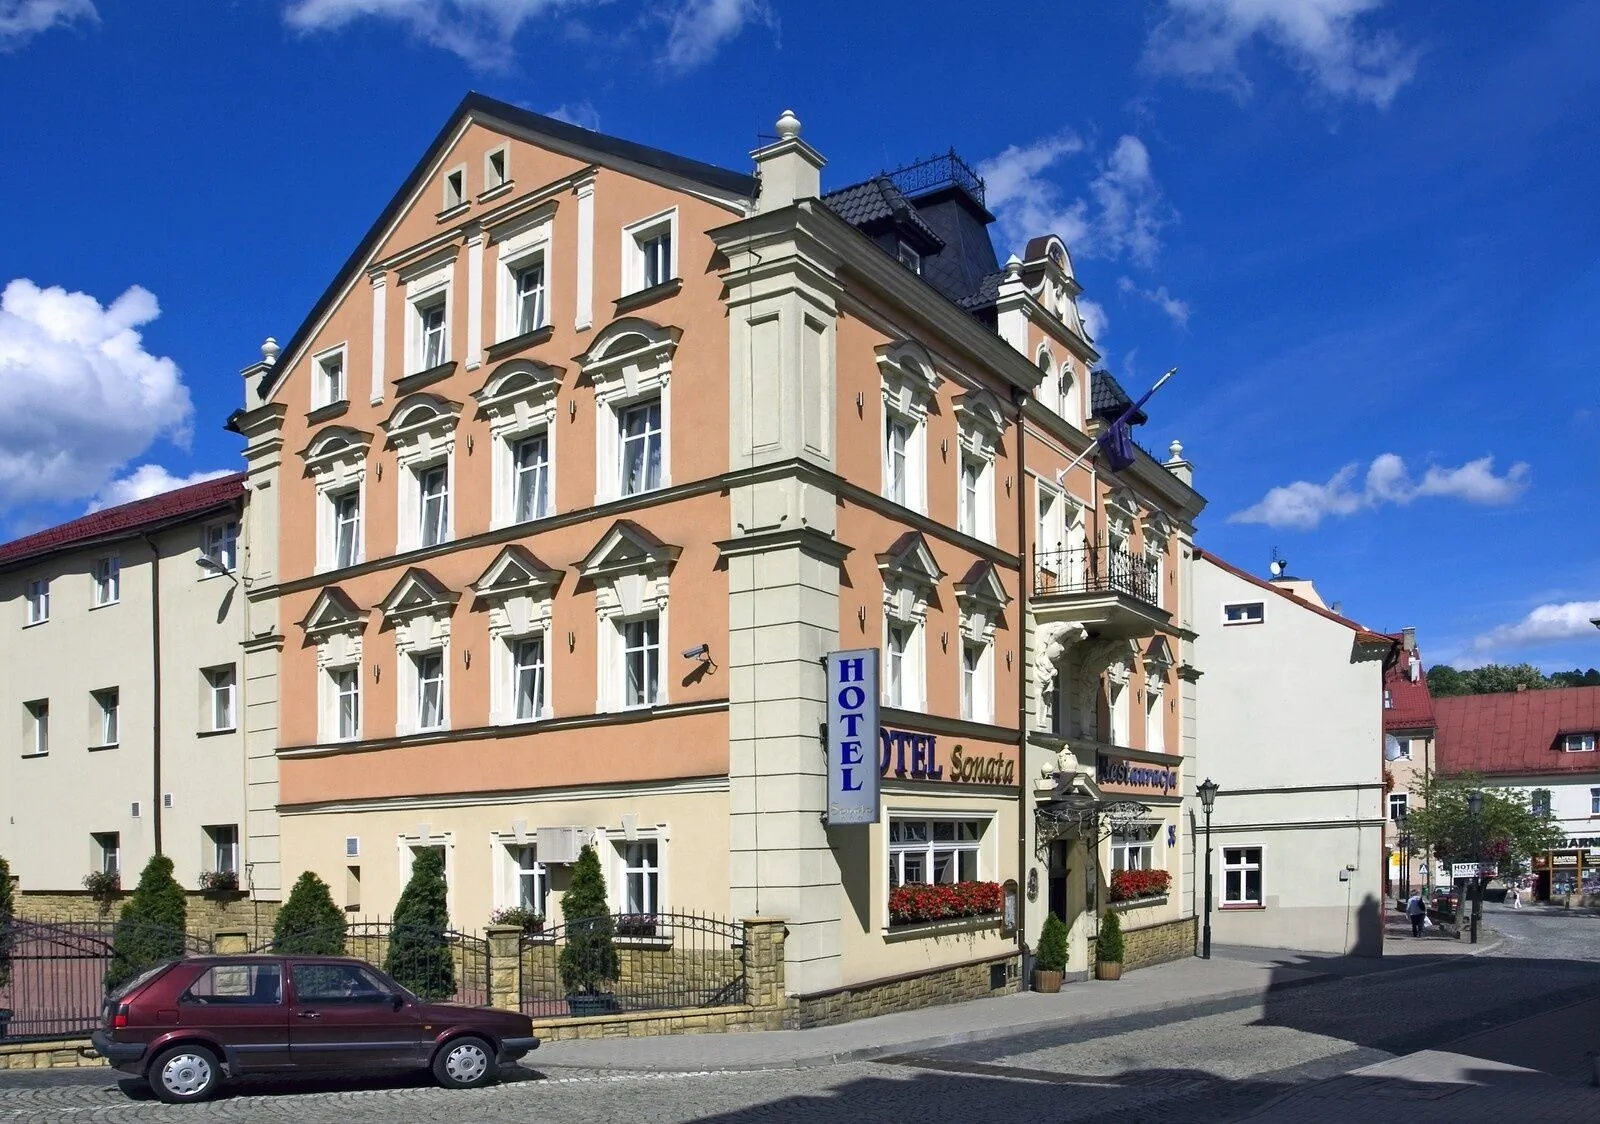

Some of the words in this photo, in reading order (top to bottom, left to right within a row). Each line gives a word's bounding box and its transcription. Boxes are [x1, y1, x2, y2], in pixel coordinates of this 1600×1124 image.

[838, 658, 866, 791] HOTEL
[880, 726, 943, 780] OTEL
[949, 744, 1015, 785] Sonata
[1097, 756, 1177, 796] Restauracja
